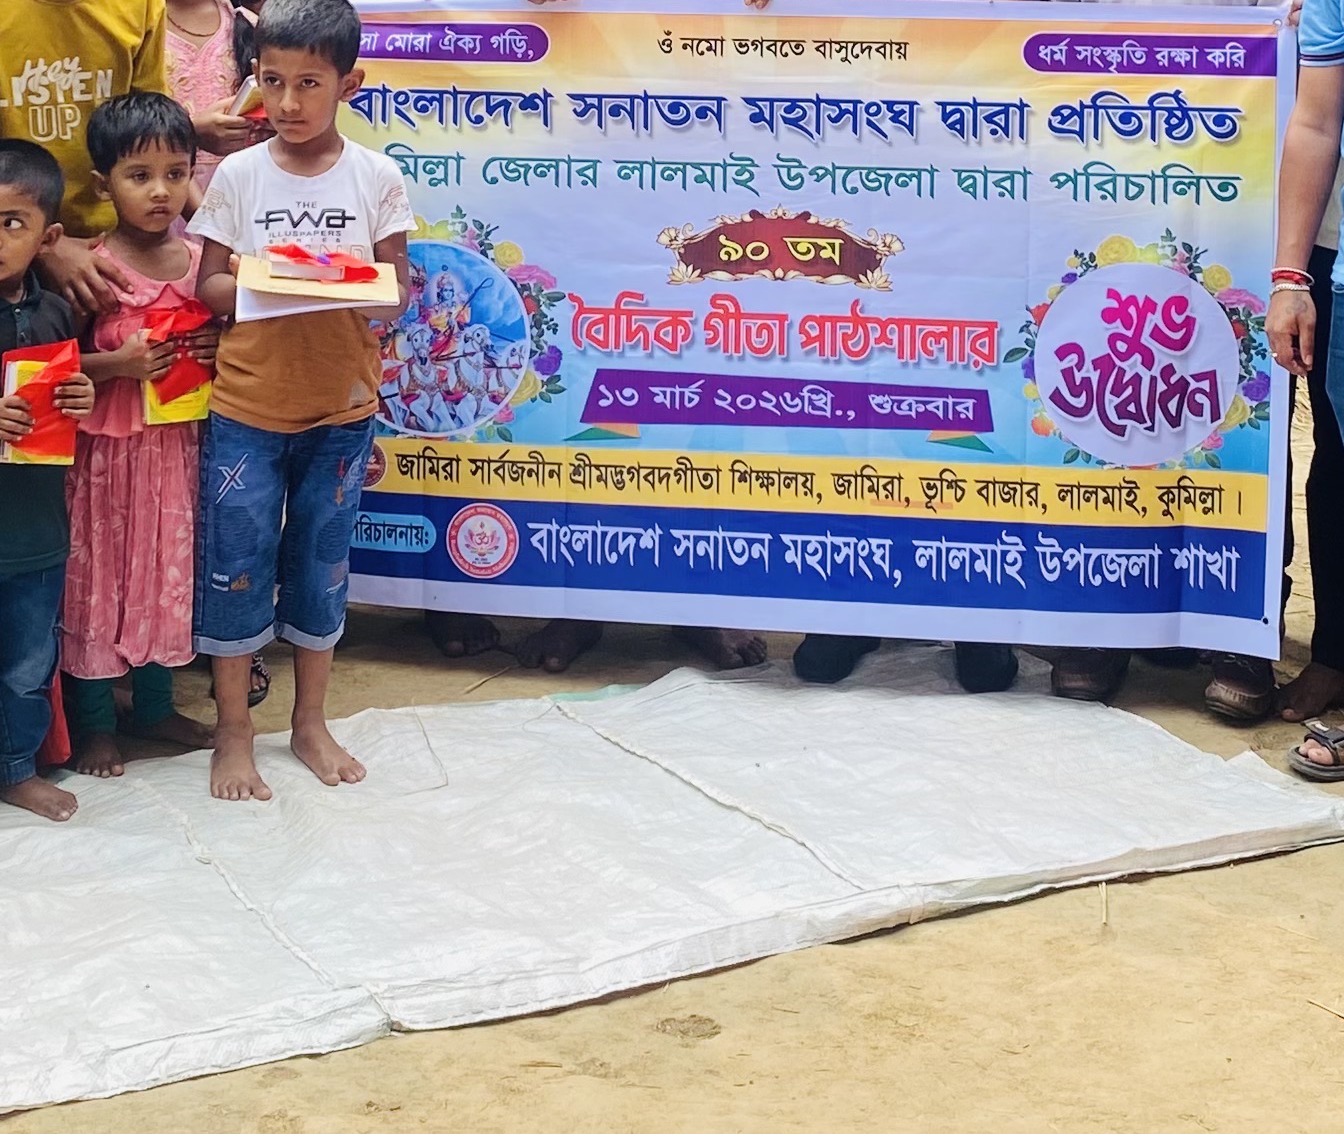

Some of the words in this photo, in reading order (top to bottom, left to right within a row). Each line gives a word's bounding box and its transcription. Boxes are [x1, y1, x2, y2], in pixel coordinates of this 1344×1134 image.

[385, 31, 432, 54] মোরা
[439, 27, 483, 55] ঐক্য
[490, 28, 535, 60] গড়ি,
[679, 36, 727, 58] নমো
[732, 36, 807, 58] ভগবতে
[812, 38, 910, 64] বাসুদেবায়
[1038, 38, 1071, 66] ধর্ম
[1075, 40, 1148, 74] সংস্কৃতি
[1154, 45, 1199, 69] রক্ষা
[1204, 42, 1247, 69] করি
[28, 103, 82, 143] UP
[348, 83, 555, 130] বাংলাদেশ
[566, 89, 728, 135] সনাতন
[741, 93, 921, 142] মহাসংঘ
[934, 97, 1033, 142] দ্বারা
[1047, 89, 1243, 145] প্রতিষ্ঠিত
[482, 154, 602, 189] জেলার
[613, 152, 761, 198] লালমাই
[772, 153, 941, 200] উপজেলা
[952, 164, 1034, 203] দ্বারা
[1049, 160, 1243, 207] পরিচালিত
[296, 201, 318, 209] THE
[718, 234, 770, 265] ৯০
[782, 235, 845, 266] তম
[566, 290, 695, 355] বৈদিক
[702, 291, 789, 358] গীতা
[798, 298, 1000, 369] পাঠশালার
[1101, 288, 1197, 371] শুভ
[597, 383, 639, 408] ১৩
[648, 380, 705, 411] মার্চ
[868, 392, 977, 422] শুক্রবার
[1048, 342, 1222, 438] উদ্বোধন
[395, 446, 462, 483] জামিরা
[467, 450, 563, 489] সার্বজনীন
[728, 459, 823, 505] শিক্ষালয়,
[831, 465, 911, 508] জামিরা,
[918, 467, 967, 513] ভূশ্চি
[974, 476, 1048, 515] বাজার,
[1056, 476, 1148, 518] লালমাই,
[1155, 475, 1226, 521] কুমিল্লা
[526, 517, 664, 568] বাংলাদেশ
[670, 524, 773, 574] সনাতন
[779, 530, 903, 588] মহাসংঘ,
[912, 530, 1027, 589] লালমাই
[1035, 531, 1163, 589] উপজেলা
[1169, 542, 1242, 593] শাখা
